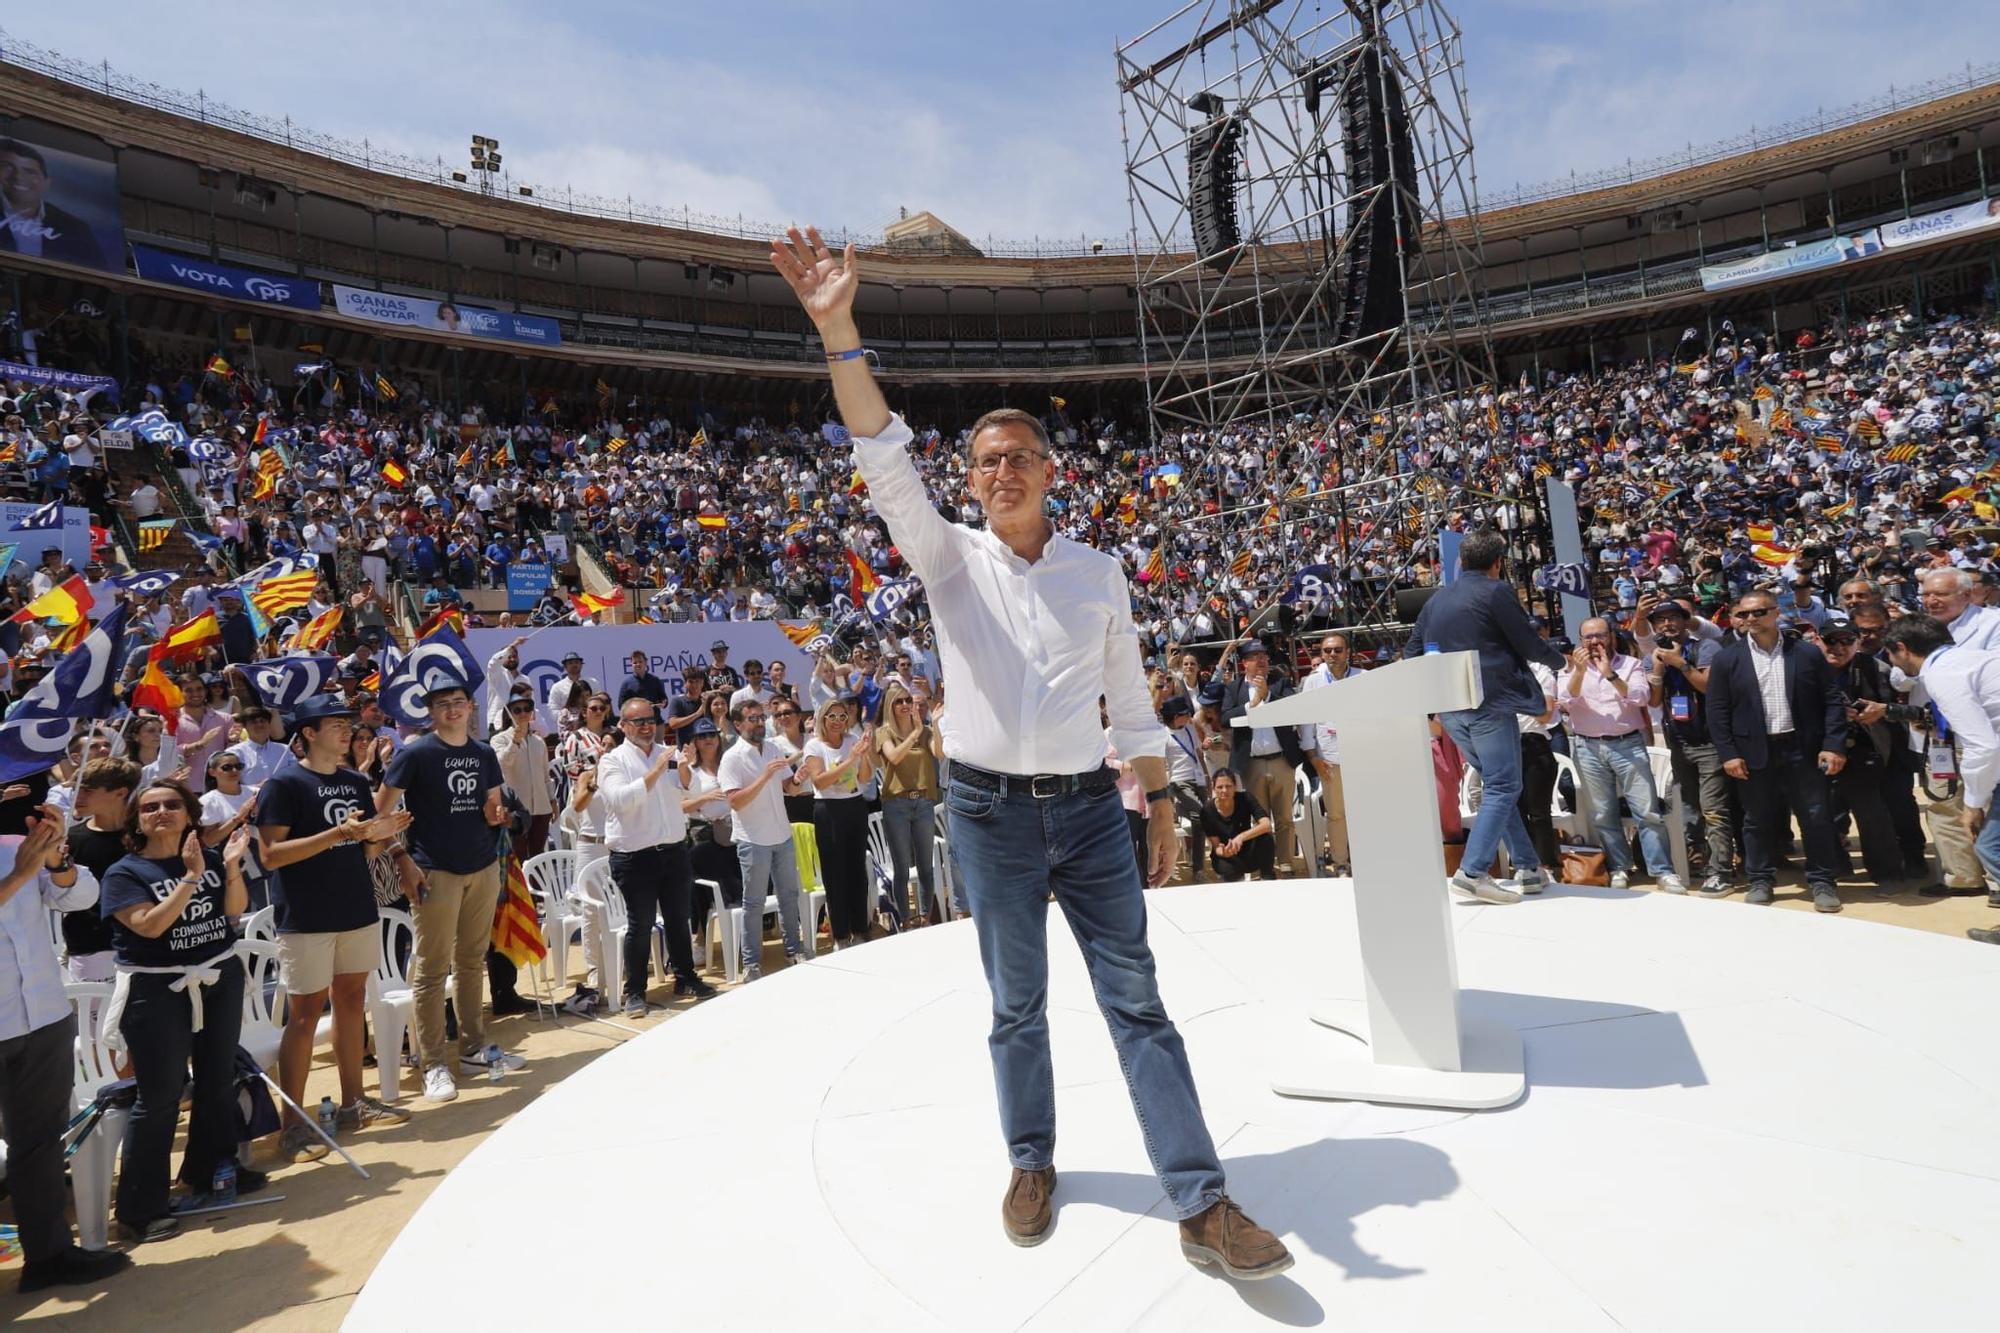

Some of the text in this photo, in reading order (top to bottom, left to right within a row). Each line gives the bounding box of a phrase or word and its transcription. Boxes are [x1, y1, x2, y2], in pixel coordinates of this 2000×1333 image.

[170, 263, 233, 289] VOTA
[1718, 267, 1760, 280] CAMBIO
[104, 439, 131, 448] ELDA
[445, 757, 480, 768] EQUIPO
[318, 785, 357, 797] EQUIPO
[170, 929, 226, 951] VALENCIAN
